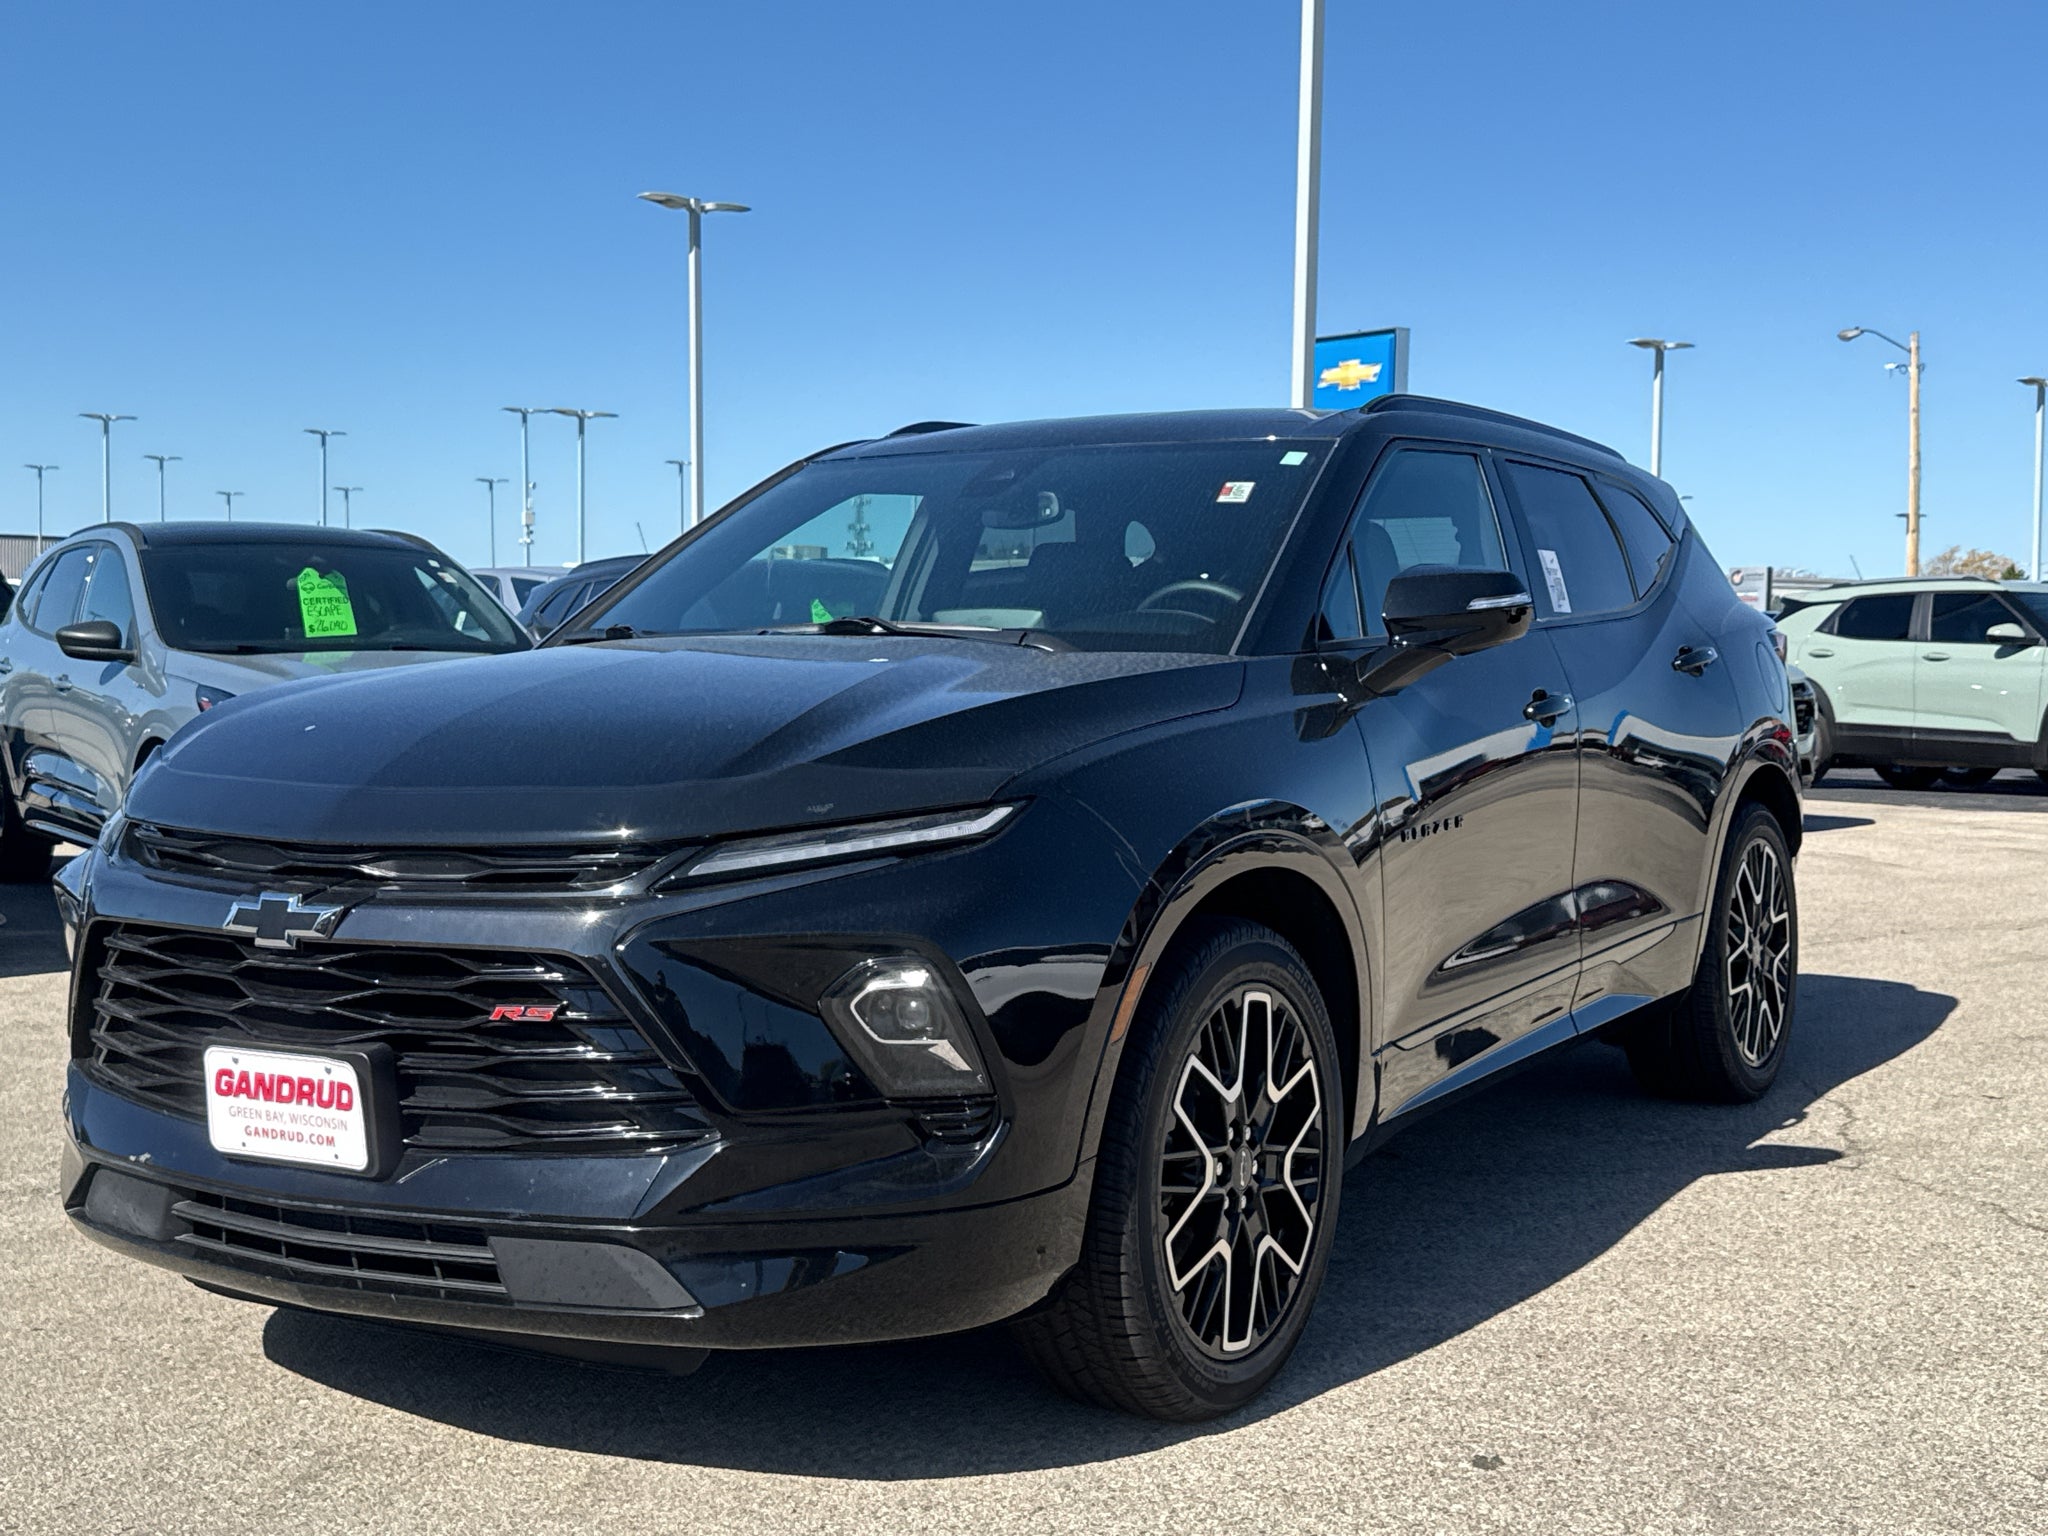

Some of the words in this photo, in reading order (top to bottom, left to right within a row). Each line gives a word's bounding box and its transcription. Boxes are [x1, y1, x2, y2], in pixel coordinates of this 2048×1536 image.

[303, 596, 349, 606] CERTIFIED
[489, 1005, 557, 1022] RS
[215, 1068, 353, 1111] GANDRUD
[229, 1105, 262, 1120] GREEN
[265, 1109, 287, 1125] BAY,
[288, 1113, 348, 1131] WISCONSIN
[244, 1125, 336, 1147] GANDRUD.COM
